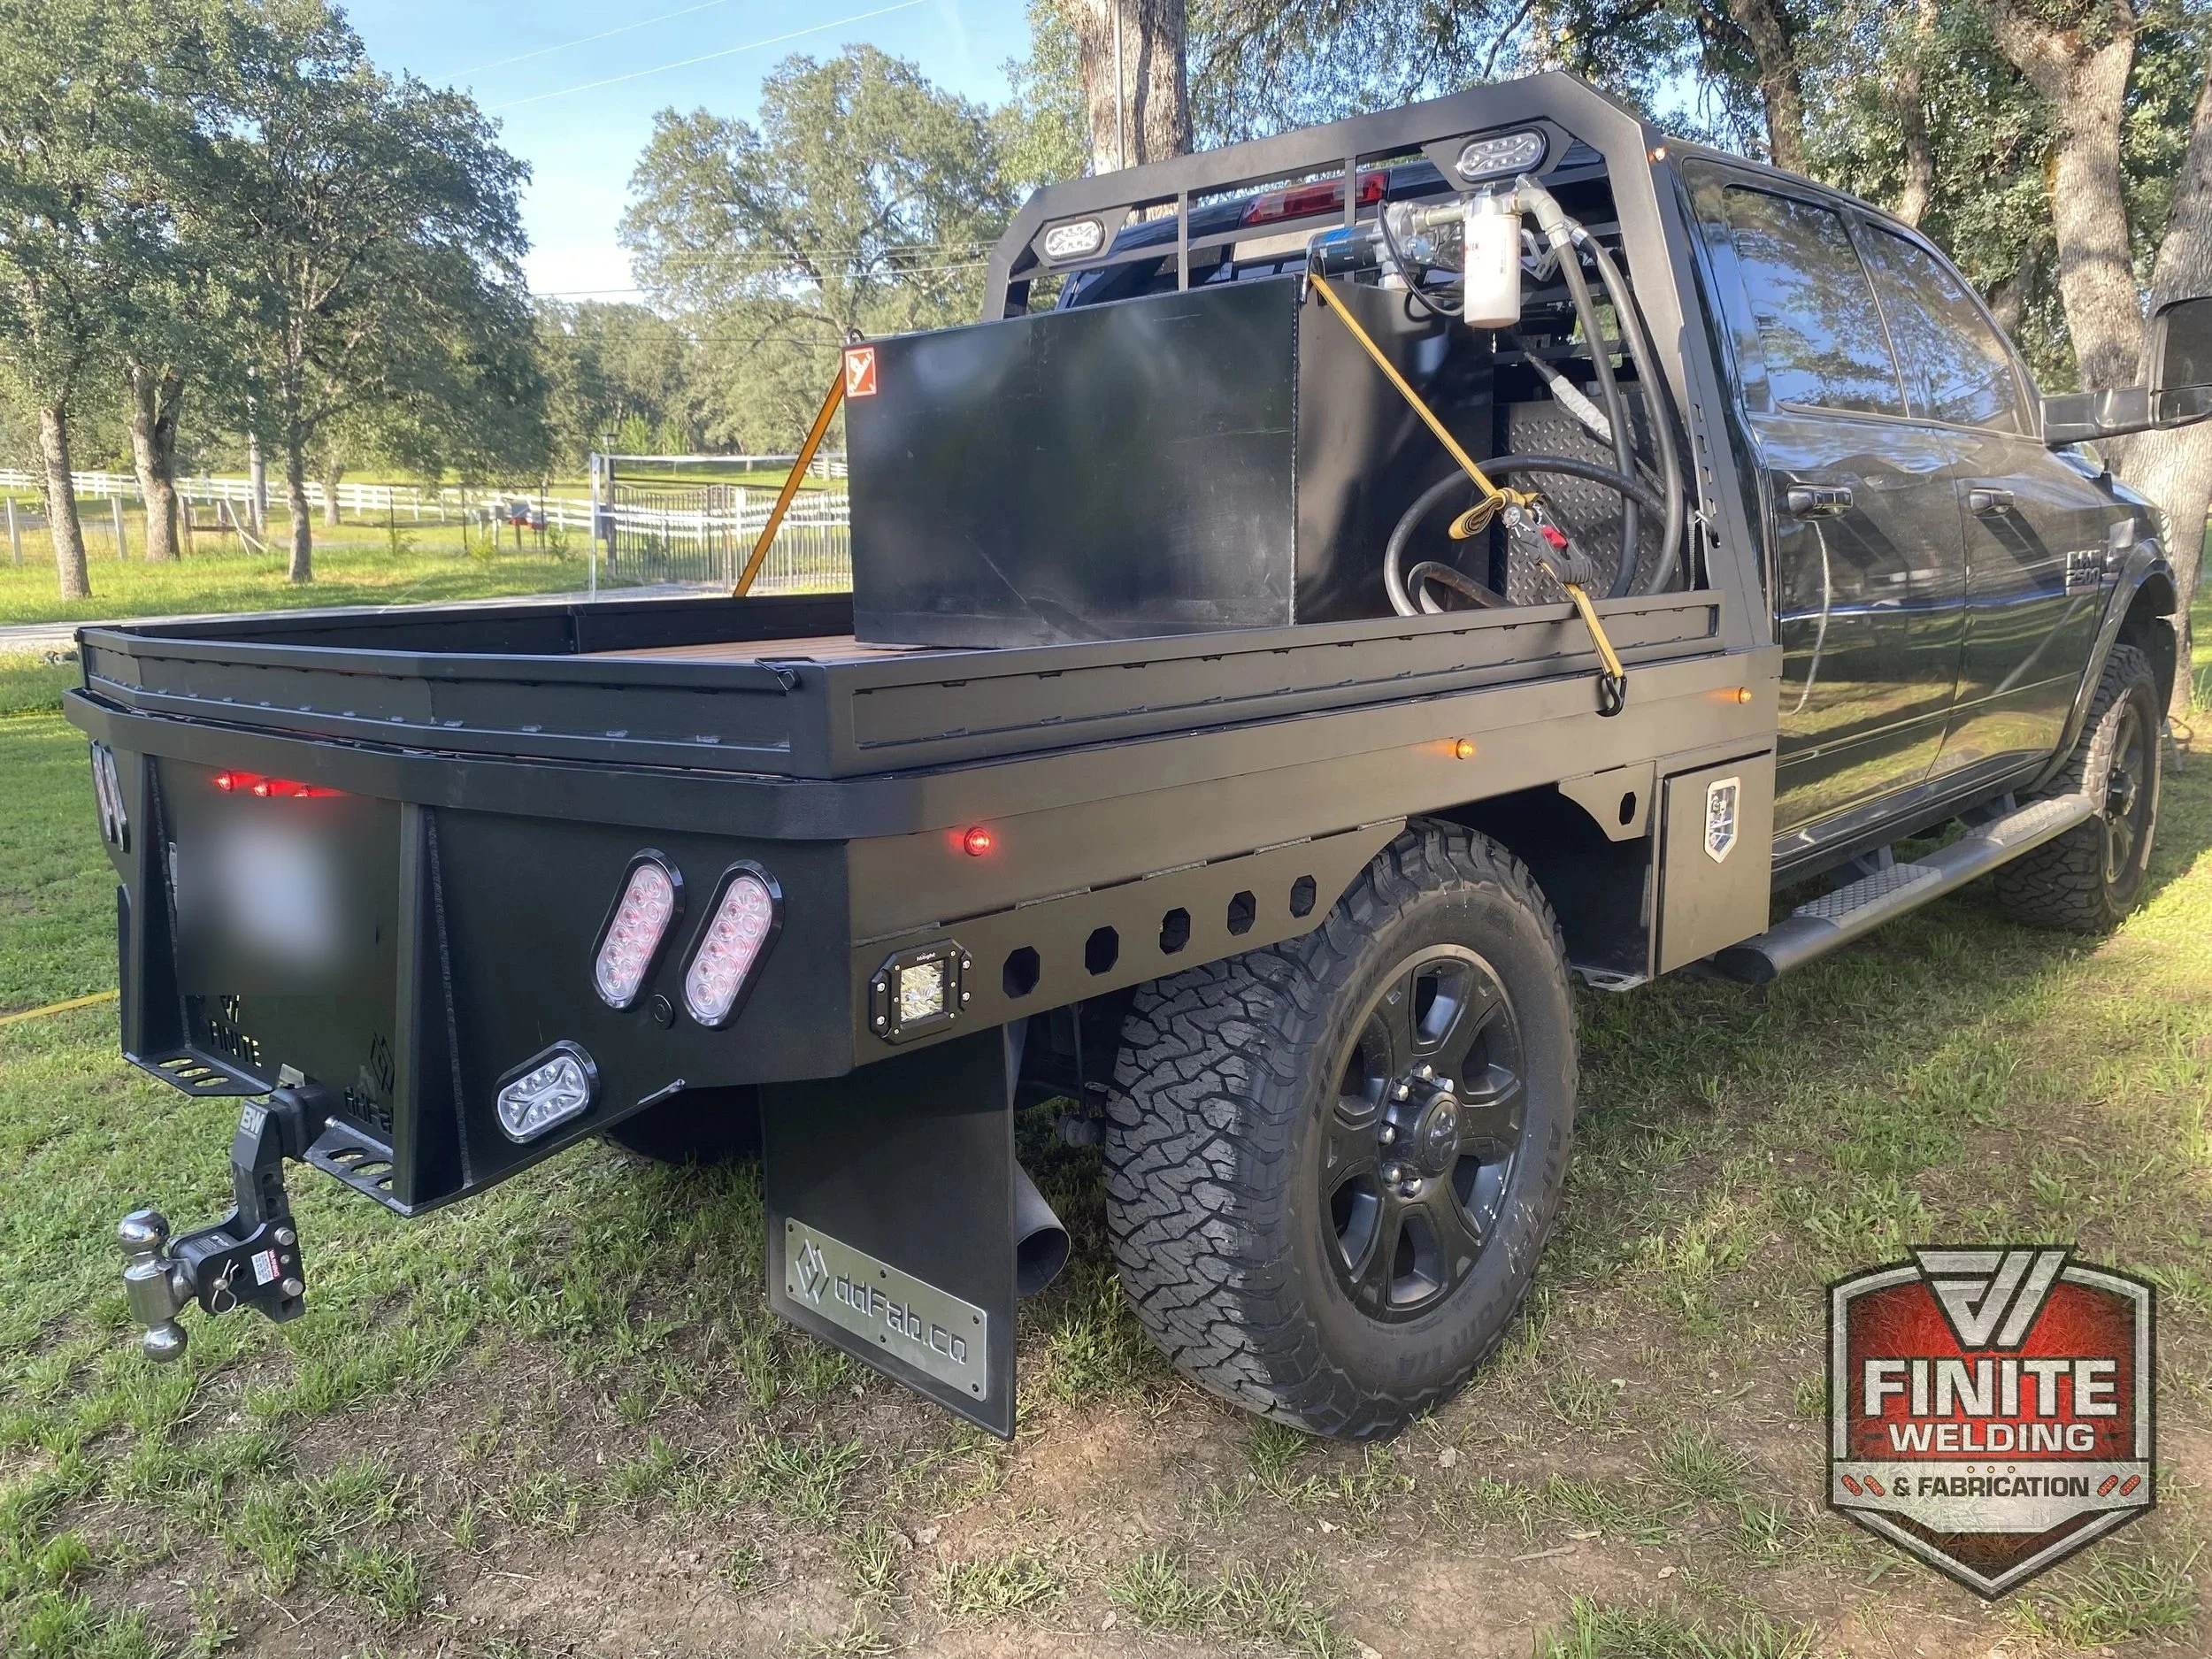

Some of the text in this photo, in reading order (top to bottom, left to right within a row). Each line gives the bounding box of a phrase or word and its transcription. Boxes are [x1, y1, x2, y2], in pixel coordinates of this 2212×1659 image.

[2067, 549, 2101, 569] RAM
[2066, 567, 2101, 586] 2500
[211, 1019, 262, 1067] FINITE
[268, 1248, 280, 1277] WARNING
[834, 1271, 967, 1365] ddFab.co
